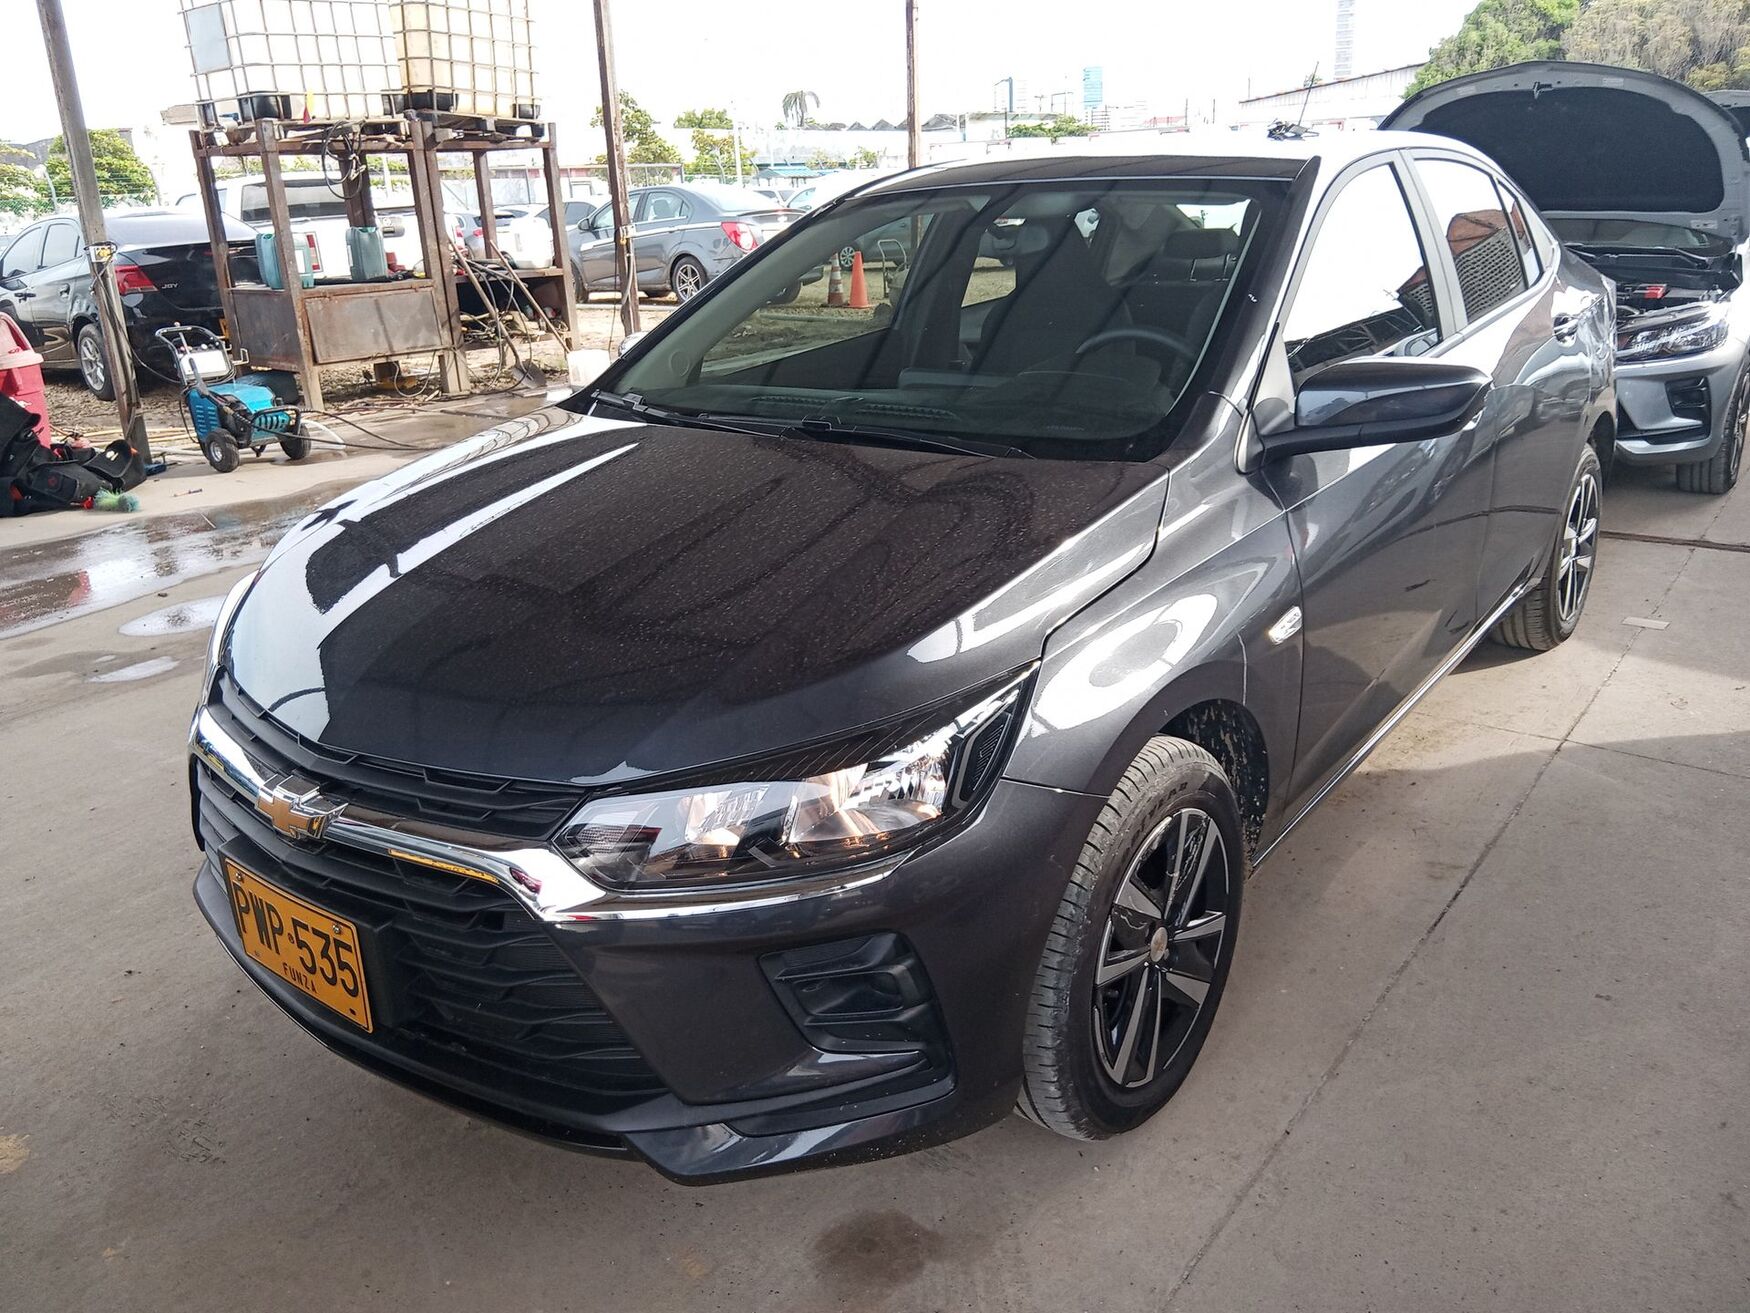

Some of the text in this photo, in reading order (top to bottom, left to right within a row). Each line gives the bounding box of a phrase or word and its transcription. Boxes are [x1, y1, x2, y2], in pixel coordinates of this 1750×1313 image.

[161, 282, 179, 290] JOY
[231, 883, 360, 998] PWP 535
[282, 961, 318, 994] FUNZA
